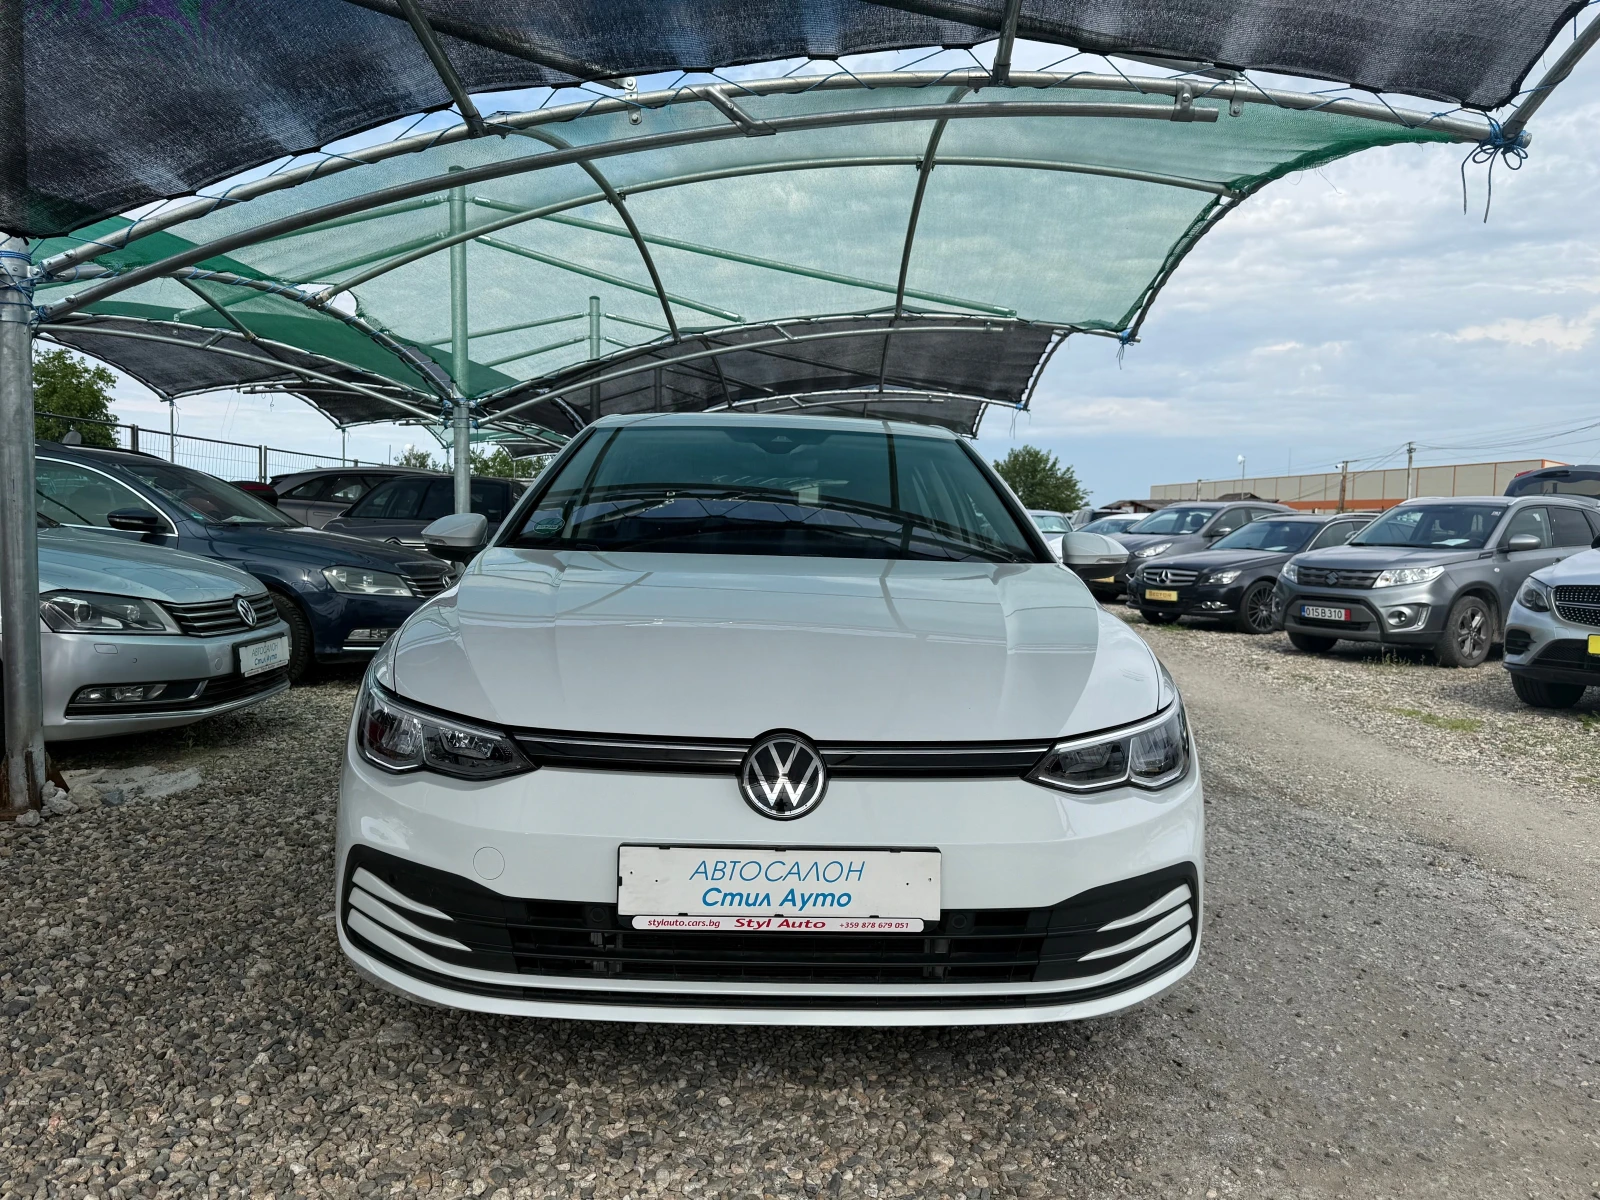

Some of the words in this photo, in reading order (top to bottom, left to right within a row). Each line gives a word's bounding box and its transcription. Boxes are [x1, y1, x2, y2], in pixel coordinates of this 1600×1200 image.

[689, 860, 866, 883] АВТОСАЛОН
[702, 887, 772, 907] Стил
[778, 888, 852, 912] Ауто
[647, 918, 721, 929] stylauto.cars.bg
[734, 918, 772, 930] Styl
[777, 918, 826, 929] Auto
[839, 921, 859, 929] +359
[861, 921, 876, 929] 878
[878, 921, 893, 929] 679
[894, 921, 909, 929] 051
